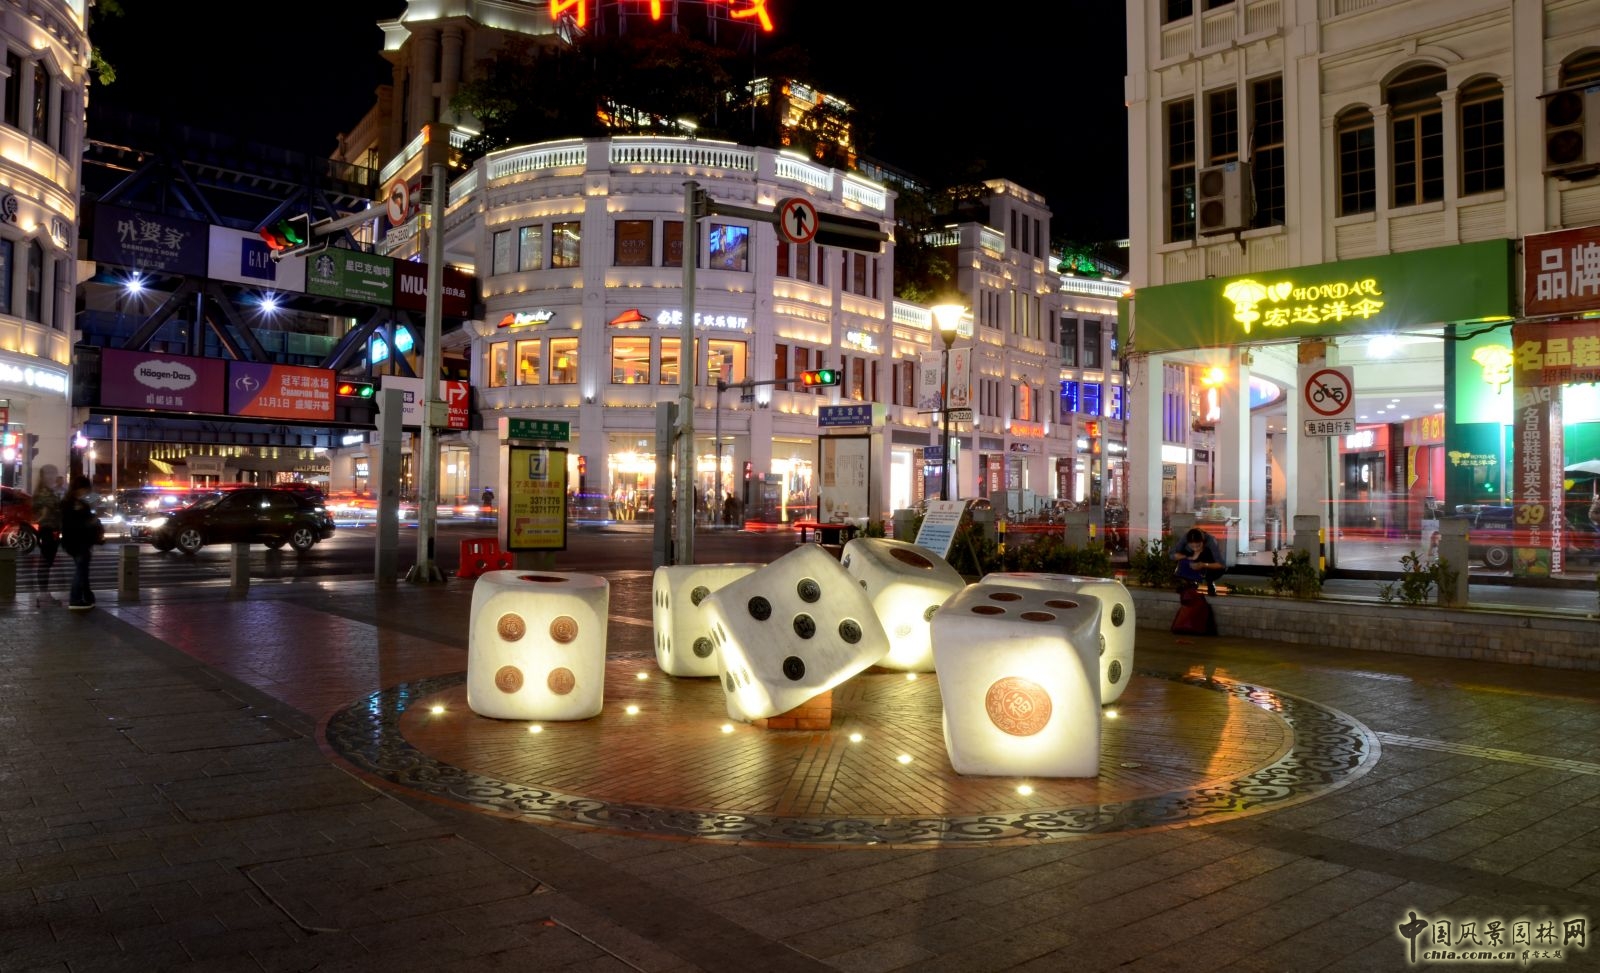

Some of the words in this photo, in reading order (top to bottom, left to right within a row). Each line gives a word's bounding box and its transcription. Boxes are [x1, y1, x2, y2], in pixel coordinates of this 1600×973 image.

[117, 213, 184, 250] 外婆家
[248, 249, 269, 269] GAP
[345, 259, 391, 277] 星巴克咖啡
[1537, 242, 1600, 301] 品牌
[1292, 278, 1383, 301] HONDAR
[1262, 297, 1384, 327] 宏达洋伞
[1514, 336, 1600, 371] 名品鞋
[140, 367, 191, 380] Häagen-Dazs
[259, 396, 290, 408] 11月1日
[1518, 386, 1551, 409] ale
[1308, 420, 1351, 434] 电动自行车
[1522, 407, 1542, 504] 名品鞋特卖会
[1516, 504, 1545, 525] 39
